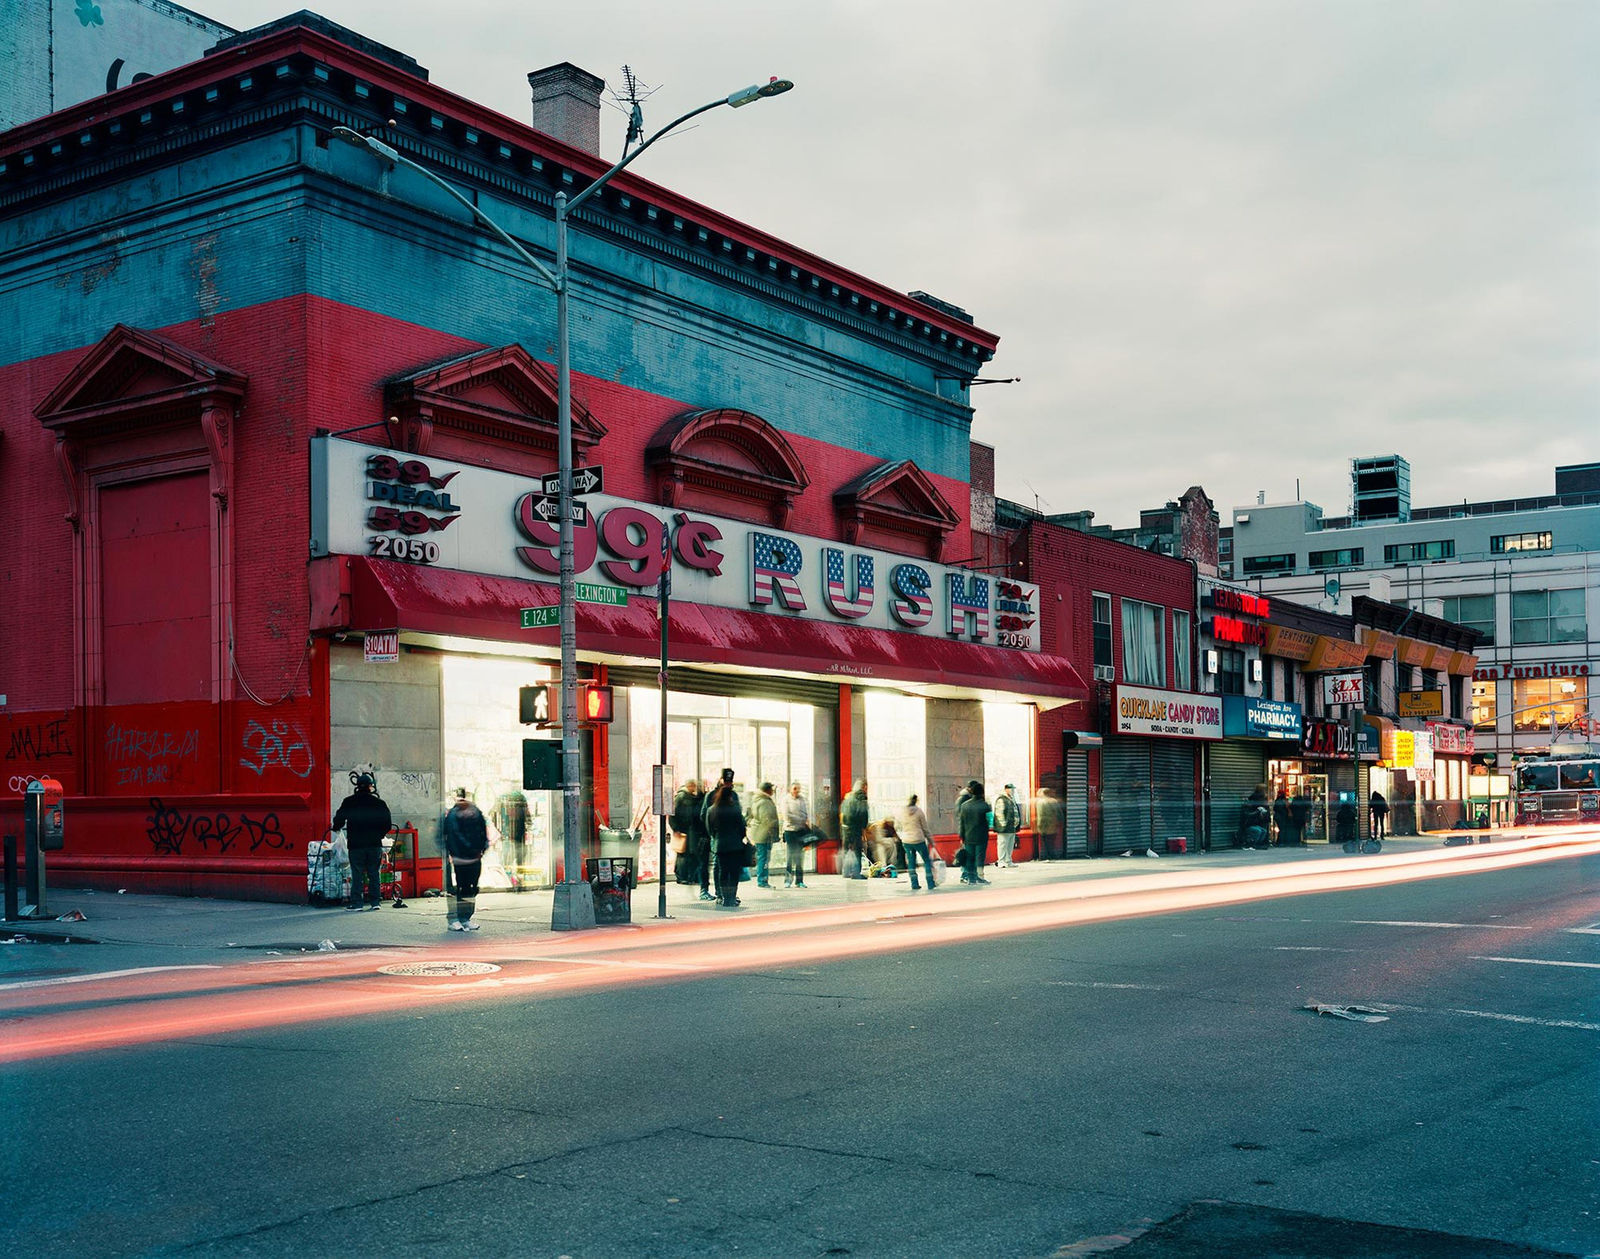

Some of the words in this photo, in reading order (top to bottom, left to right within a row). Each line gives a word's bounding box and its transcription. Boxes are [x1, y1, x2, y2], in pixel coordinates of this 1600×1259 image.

[574, 475, 593, 488] WAY
[367, 481, 461, 512] DEAL
[540, 503, 557, 516] ONE
[370, 534, 440, 562] 2050
[576, 583, 617, 603] LEXINGTON
[749, 531, 990, 638] RUSH
[524, 612, 529, 626] E
[533, 609, 547, 624] 124
[550, 608, 557, 616] ST
[999, 632, 1031, 648] 2050
[1213, 615, 1270, 647] PHARMACY
[1502, 662, 1589, 680] Furniture
[1256, 700, 1282, 711] Lexington
[1333, 691, 1361, 703] DELI
[1120, 697, 1166, 721] QUICKLANE
[1168, 702, 1195, 724] CANDY
[1196, 705, 1220, 726] STORE
[1248, 709, 1296, 727] PHARMACY
[105, 722, 199, 763] HARLEM
[1337, 724, 1356, 752] DEL
